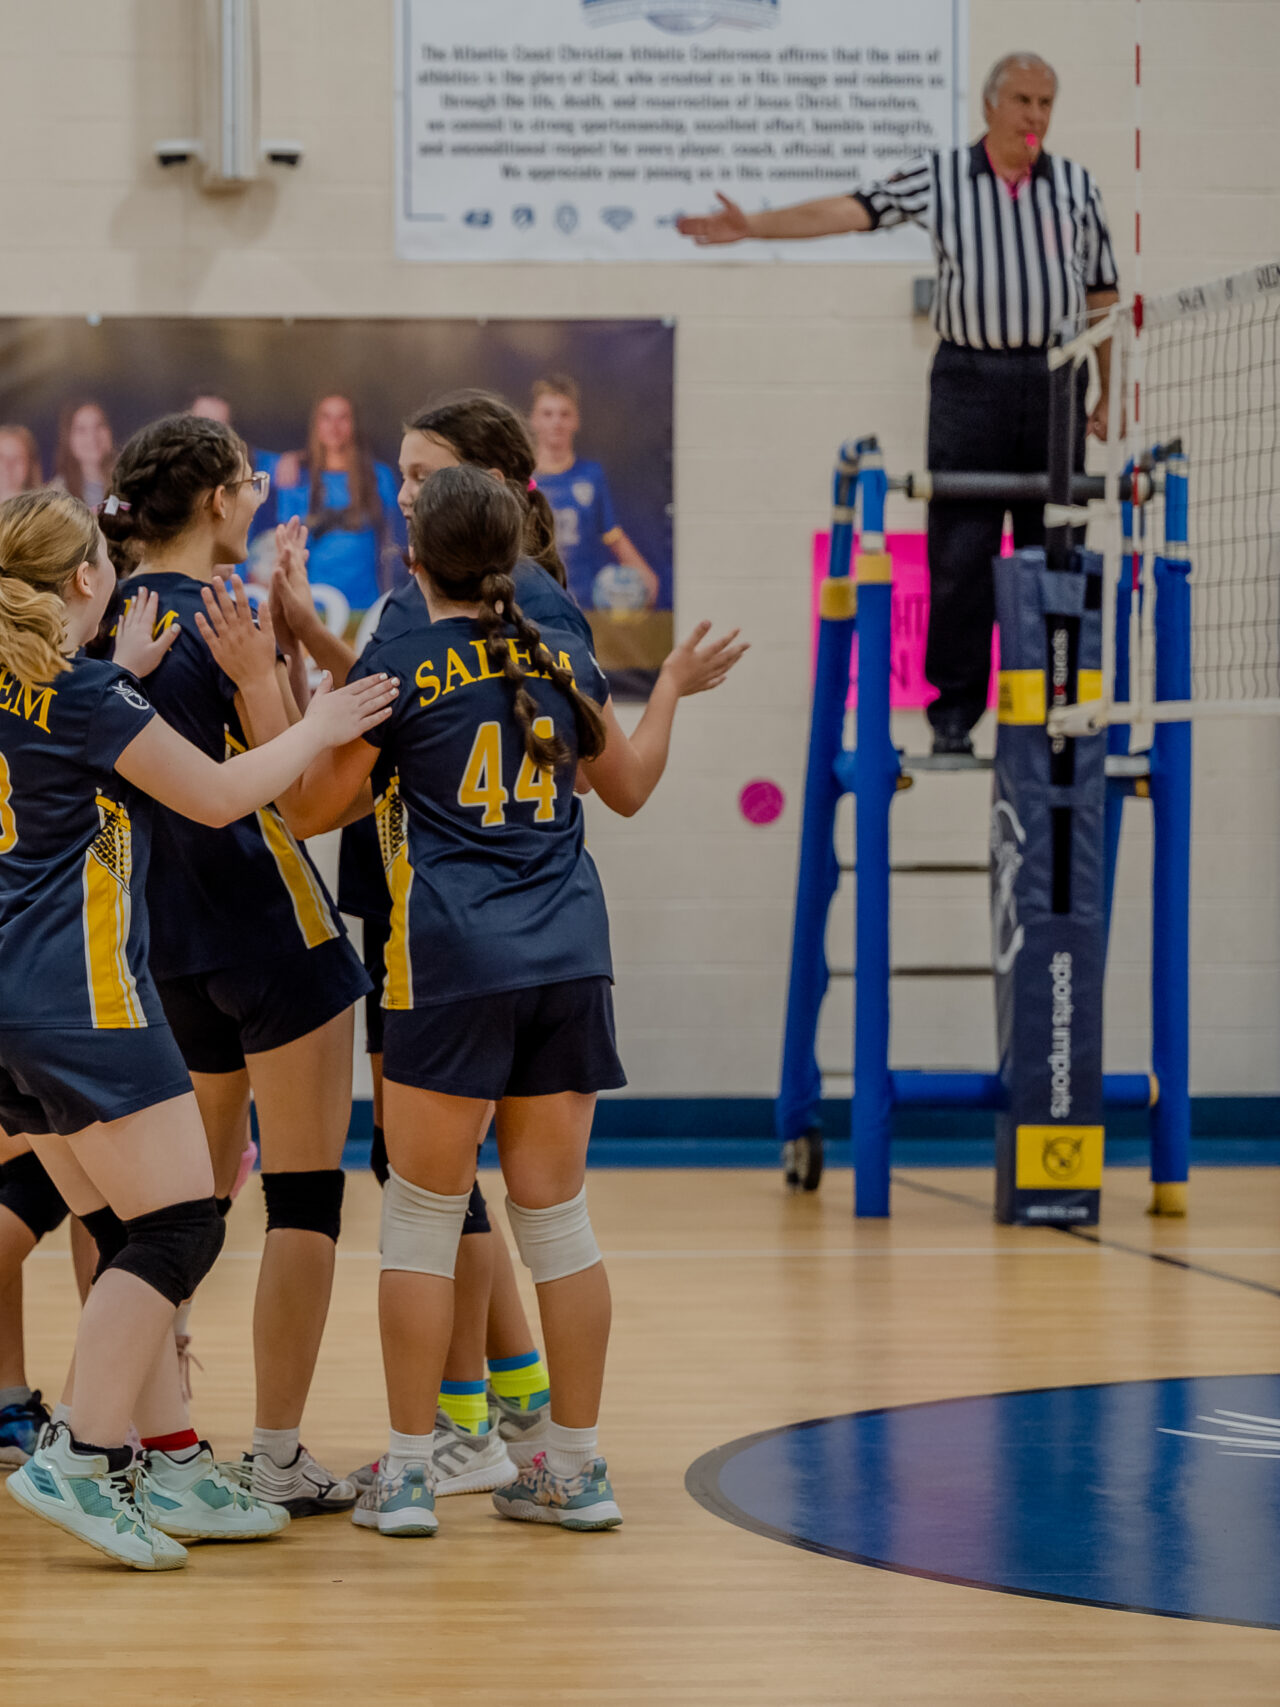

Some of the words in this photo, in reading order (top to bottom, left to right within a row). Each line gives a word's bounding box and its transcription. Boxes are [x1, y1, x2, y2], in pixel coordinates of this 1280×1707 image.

[457, 716, 558, 828] 44
[1048, 951, 1074, 1027] sports
[1047, 1027, 1073, 1118] imports
